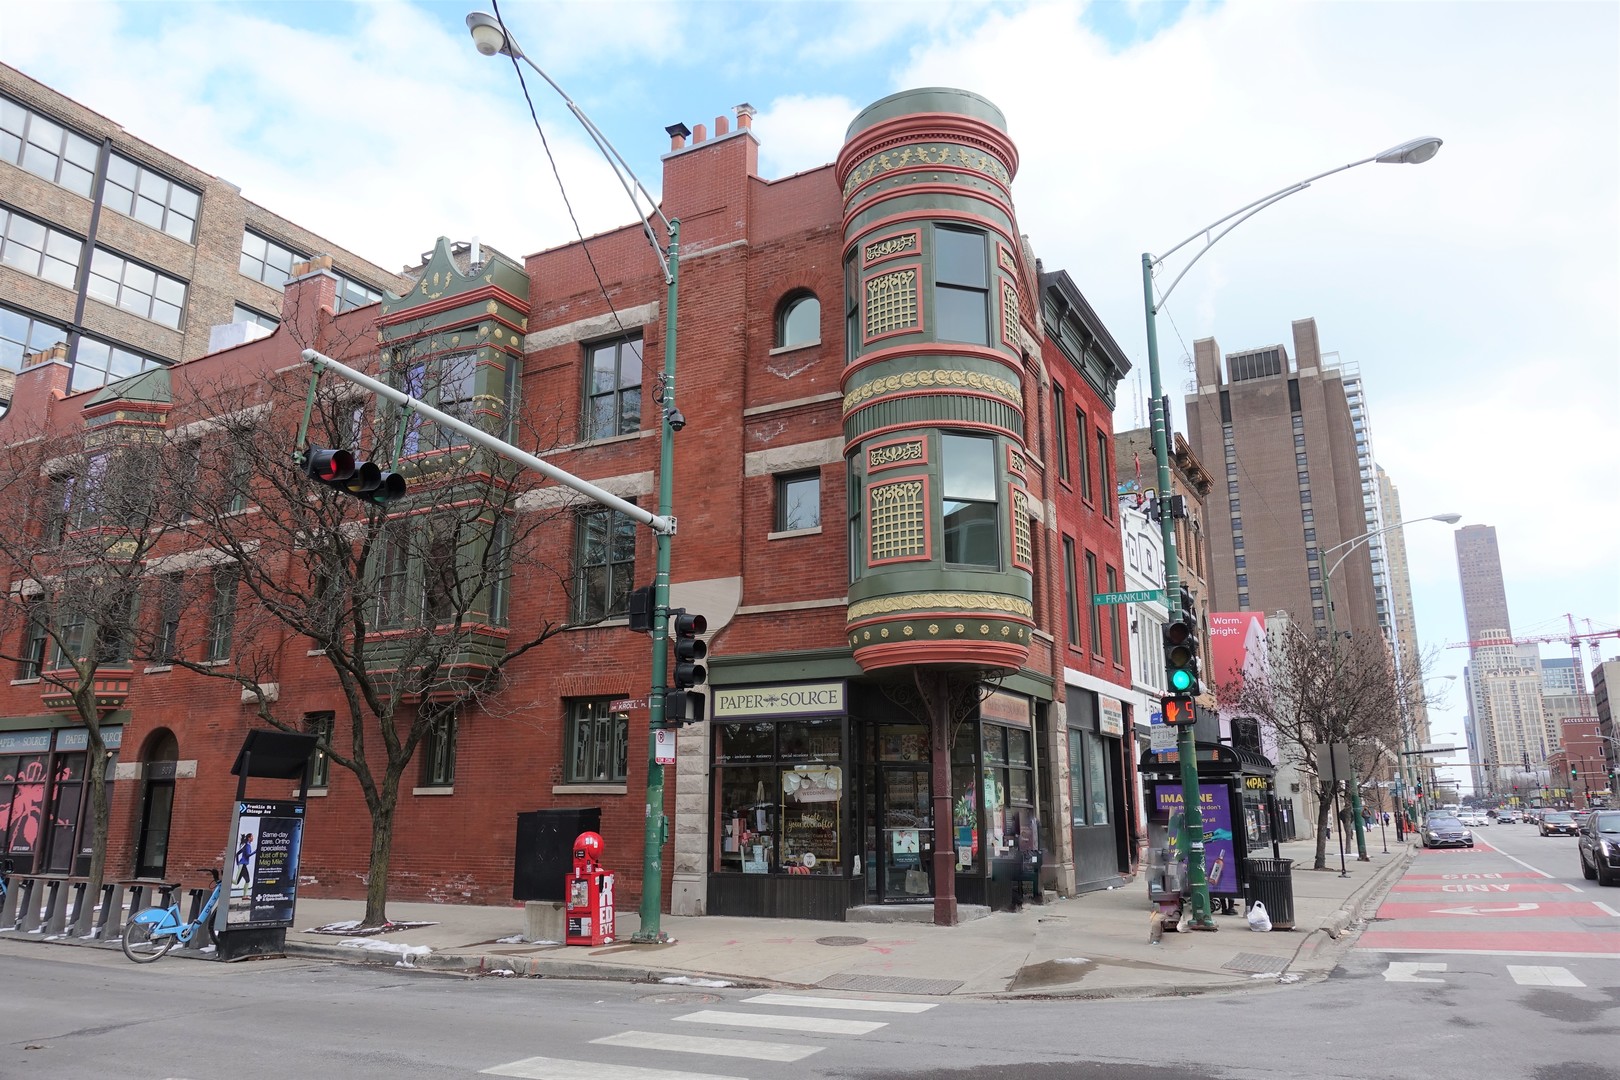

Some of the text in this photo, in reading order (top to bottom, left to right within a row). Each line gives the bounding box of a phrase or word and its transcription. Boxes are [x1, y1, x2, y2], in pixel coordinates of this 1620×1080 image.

[1105, 591, 1151, 603] FRANKLIN
[1213, 617, 1242, 625] Warm.
[1210, 627, 1240, 637] Bright.
[720, 690, 837, 709] PAPER SOURCE
[618, 702, 638, 710] KROLL
[1185, 701, 1194, 719] 5
[22, 736, 48, 746] SOURCE
[64, 732, 122, 744] PAPER OURCE
[1252, 777, 1268, 789] PAR
[1160, 794, 1213, 803] IMANE
[1442, 884, 1510, 892] AND
[600, 906, 613, 924] ED
[600, 924, 613, 936] EYE
